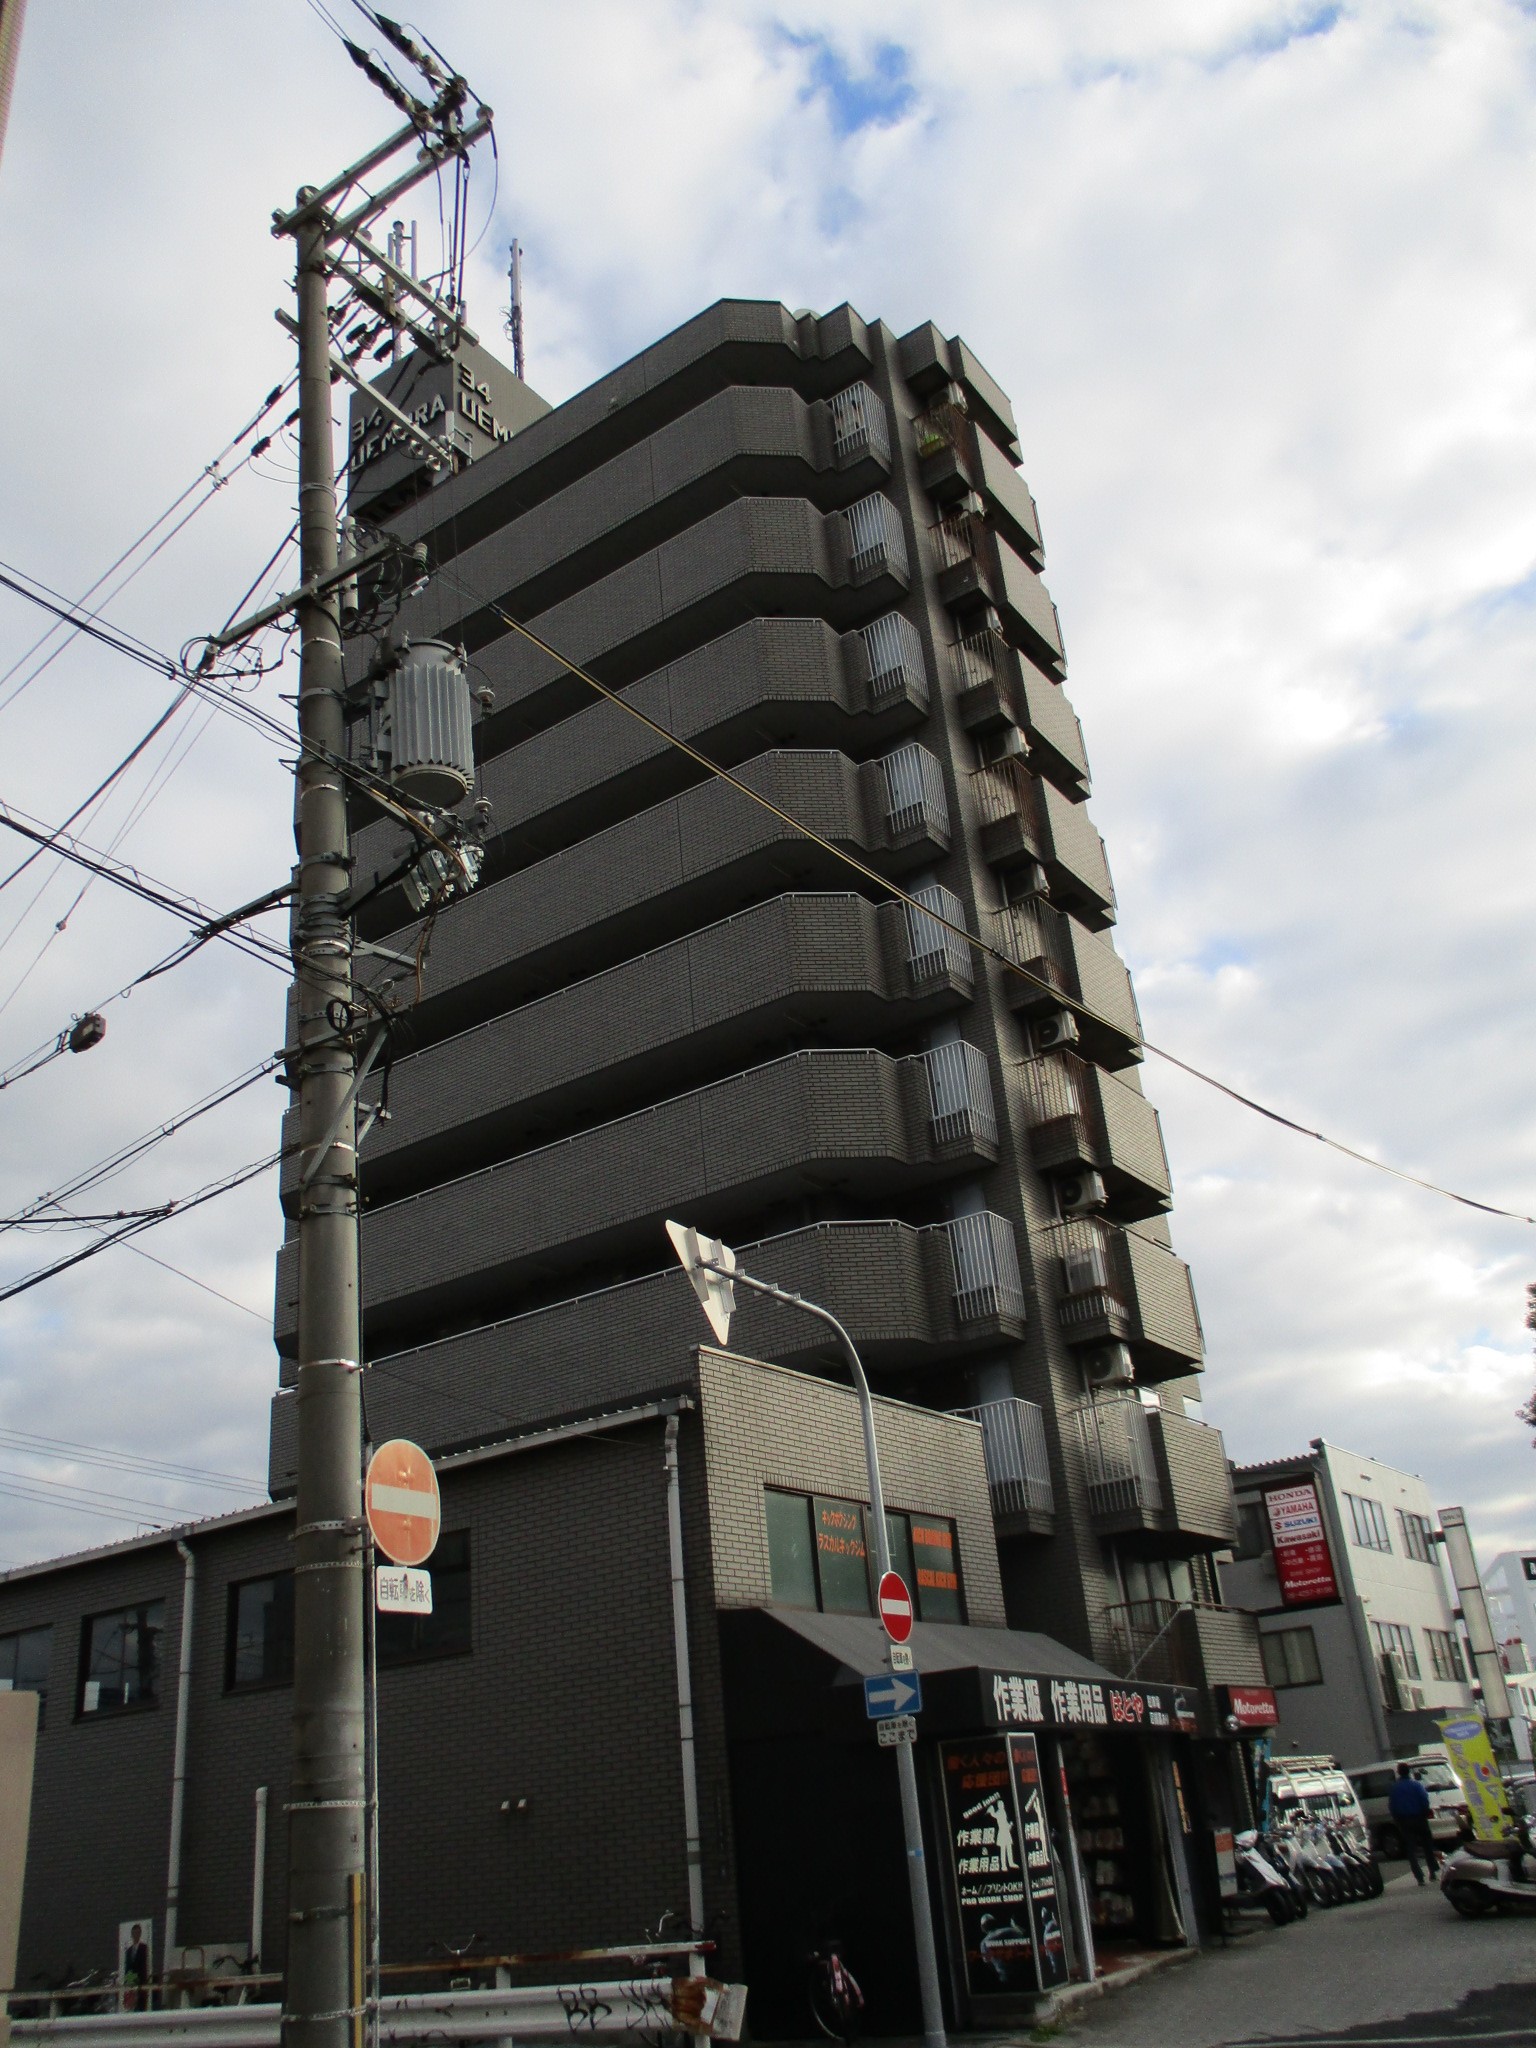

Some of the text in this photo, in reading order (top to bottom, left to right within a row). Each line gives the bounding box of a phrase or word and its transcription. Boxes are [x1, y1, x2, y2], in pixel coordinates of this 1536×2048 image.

[460, 391, 515, 443] UEM
[351, 393, 446, 473] UEMRA
[1269, 1488, 1312, 1502] HONDA
[1281, 1502, 1314, 1515] YAMAHA
[1284, 1516, 1318, 1528] SUZUKI
[1277, 1530, 1321, 1544] Kawasaki
[1284, 1576, 1332, 1590] Motoretta
[993, 1674, 1044, 1722] 作業服
[1050, 1679, 1108, 1725] 作業用品
[1233, 1697, 1275, 1716] Motoretta
[880, 1728, 915, 1744] ここまで
[956, 1826, 996, 1848] 作業服
[958, 1855, 1001, 1875] 作業用品
[960, 1896, 977, 1906] PRO
[977, 1894, 1002, 1904] WORK
[1002, 1893, 1024, 1903] SHOP
